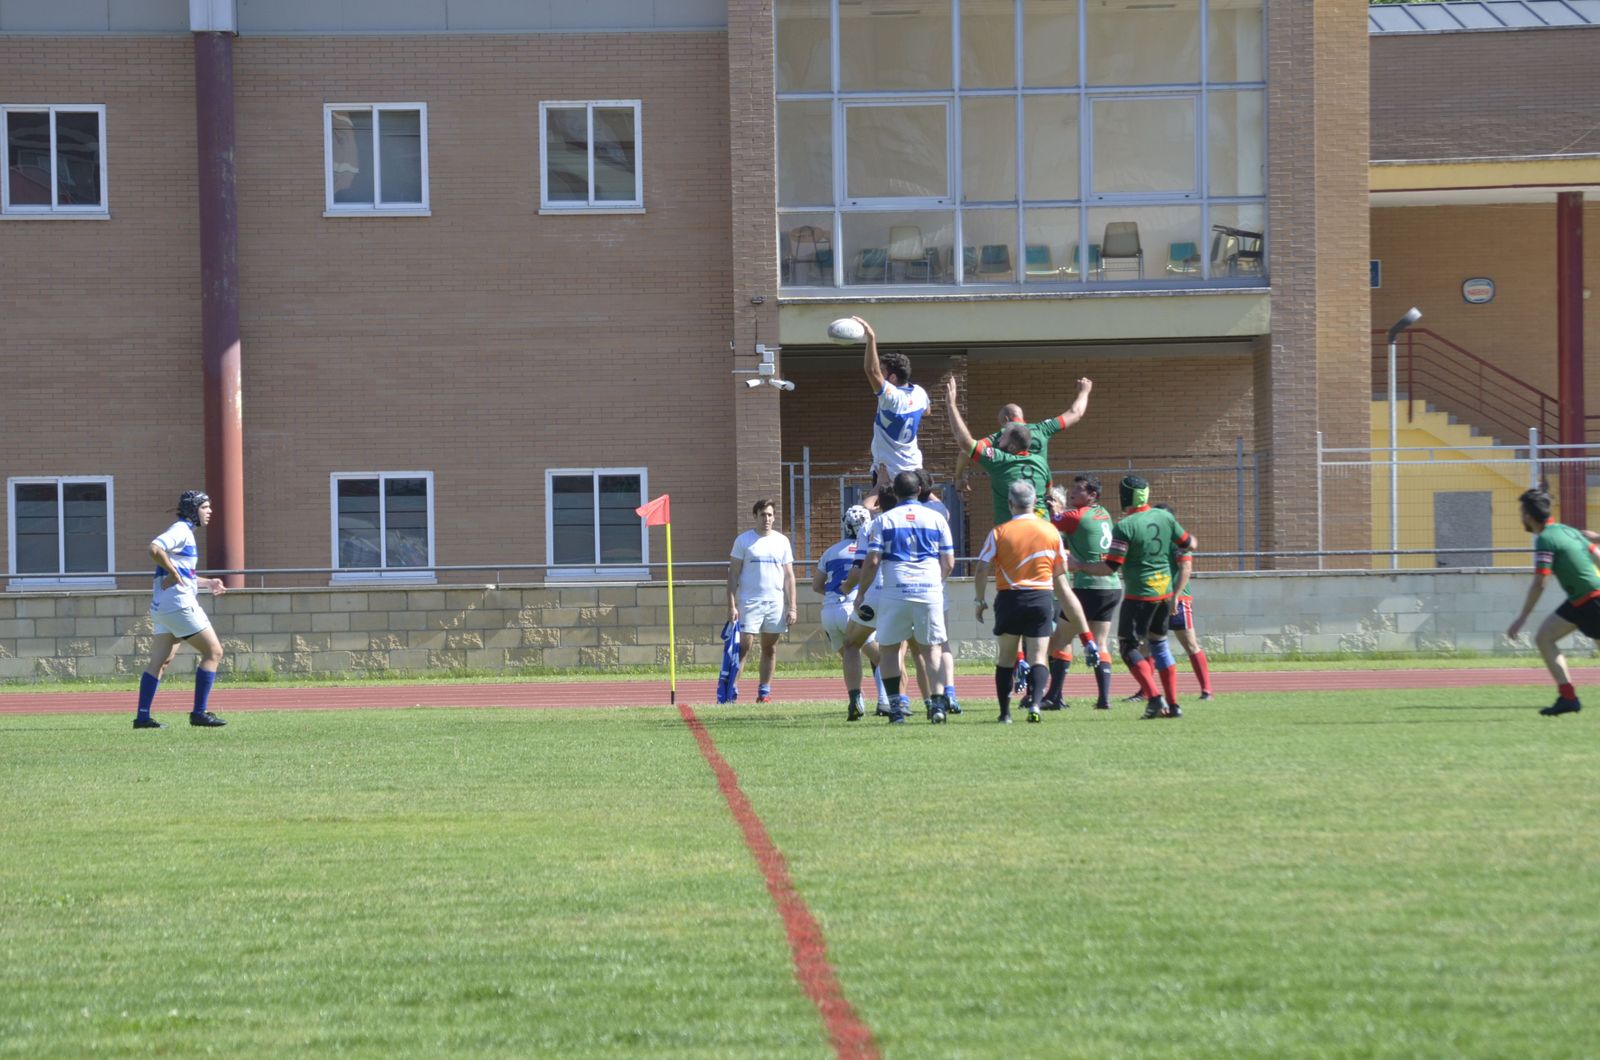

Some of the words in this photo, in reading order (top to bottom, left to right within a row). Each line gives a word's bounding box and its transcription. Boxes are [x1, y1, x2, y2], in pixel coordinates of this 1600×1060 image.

[898, 417, 914, 443] 6
[1100, 522, 1113, 549] 8
[1146, 523, 1162, 556] 3
